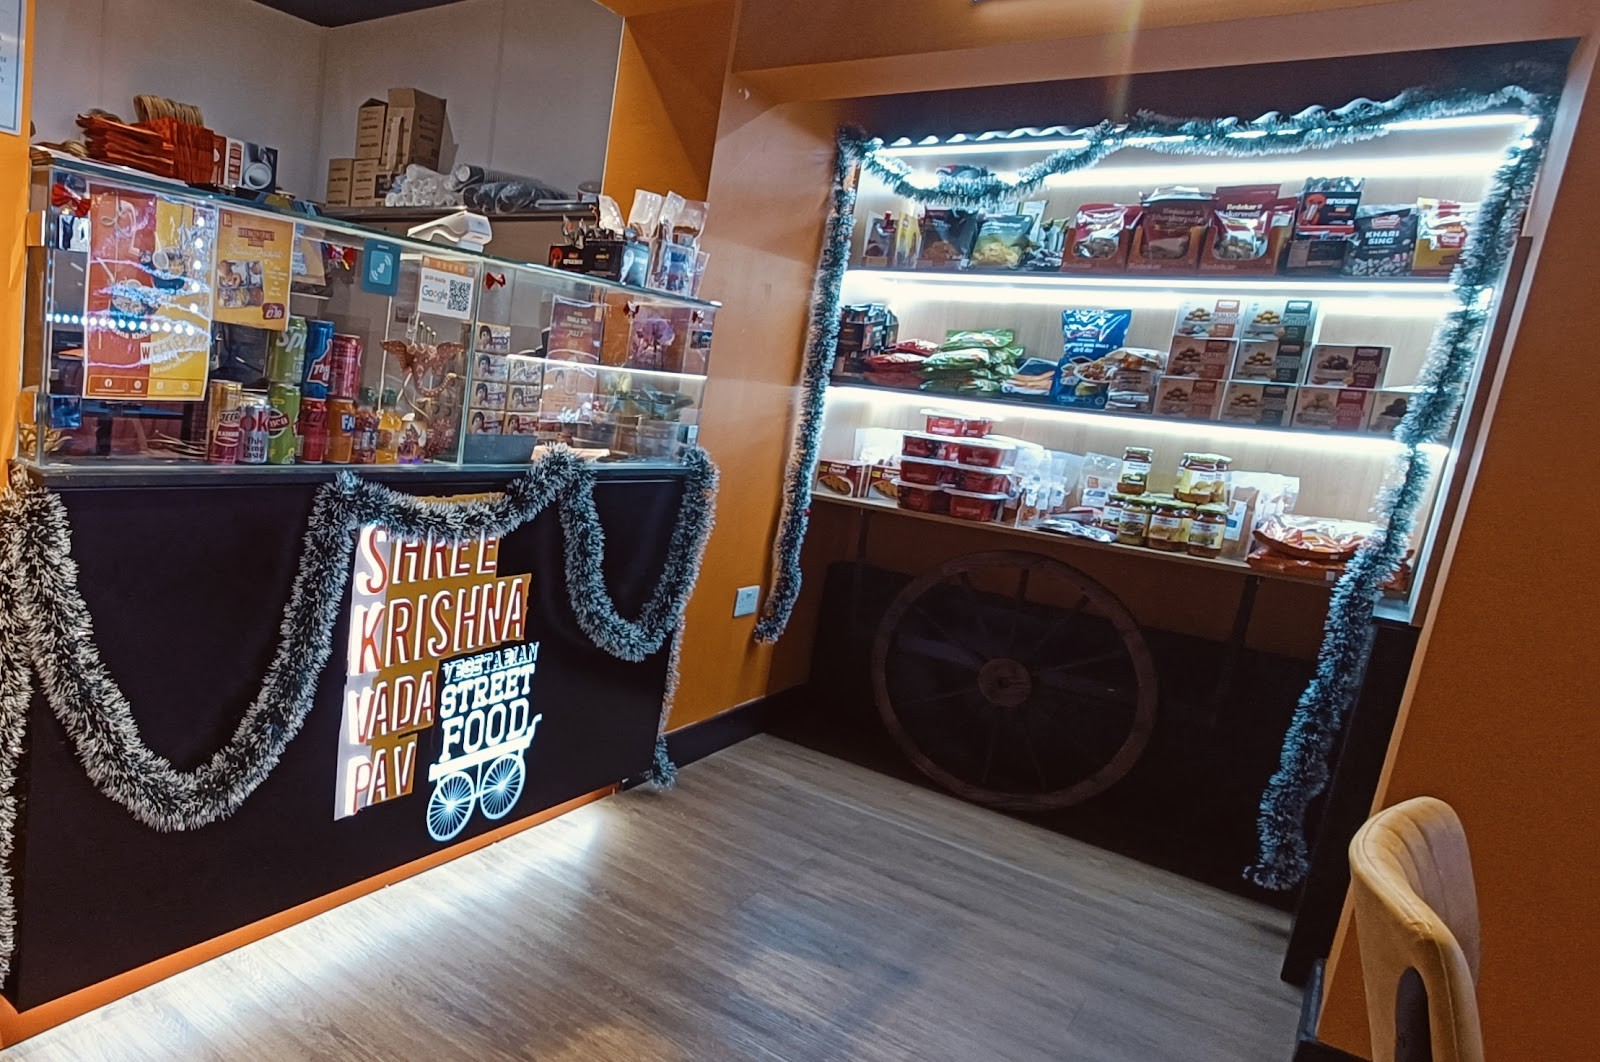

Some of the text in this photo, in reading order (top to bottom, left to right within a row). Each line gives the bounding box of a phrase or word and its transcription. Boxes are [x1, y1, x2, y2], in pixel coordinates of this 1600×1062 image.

[1364, 230, 1400, 238] KHARI
[1367, 237, 1394, 245] SING
[421, 284, 448, 302] Google
[240, 411, 268, 432] ok
[355, 523, 497, 596] SHREE
[349, 577, 524, 677] KRISHNA
[439, 663, 536, 719] STREET
[442, 641, 540, 685] VEGETARIAN
[347, 670, 434, 745] VADA
[438, 698, 530, 763] FOOD
[344, 741, 416, 816] PAV
